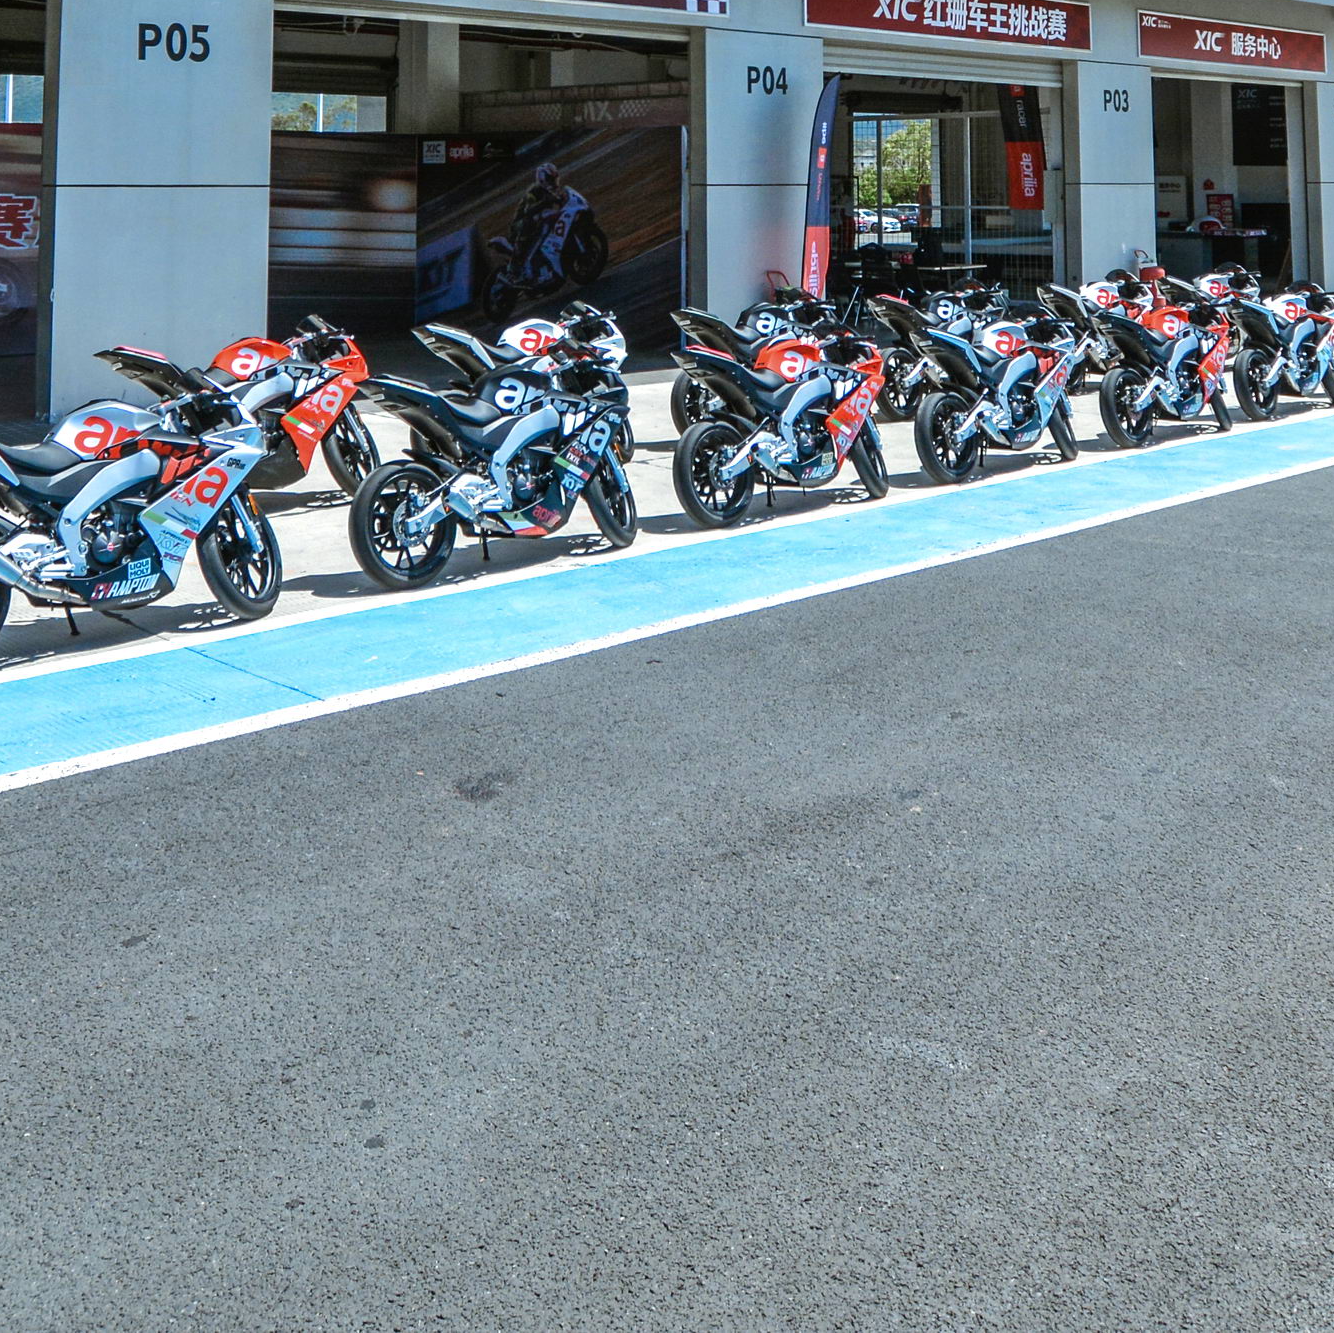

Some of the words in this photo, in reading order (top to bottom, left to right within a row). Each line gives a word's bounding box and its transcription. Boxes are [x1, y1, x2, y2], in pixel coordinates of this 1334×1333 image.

[137, 22, 211, 63] P05
[1194, 30, 1225, 52] XIC
[1231, 32, 1282, 60] 服务中心
[747, 65, 788, 96] P04
[1104, 89, 1130, 113] P03
[426, 143, 442, 153] XIC
[449, 145, 474, 159] aprilia
[1020, 153, 1038, 197] aprilia
[130, 560, 150, 569] LIQUI
[130, 568, 150, 577] MOLY
[91, 573, 160, 600] CHAMPION
